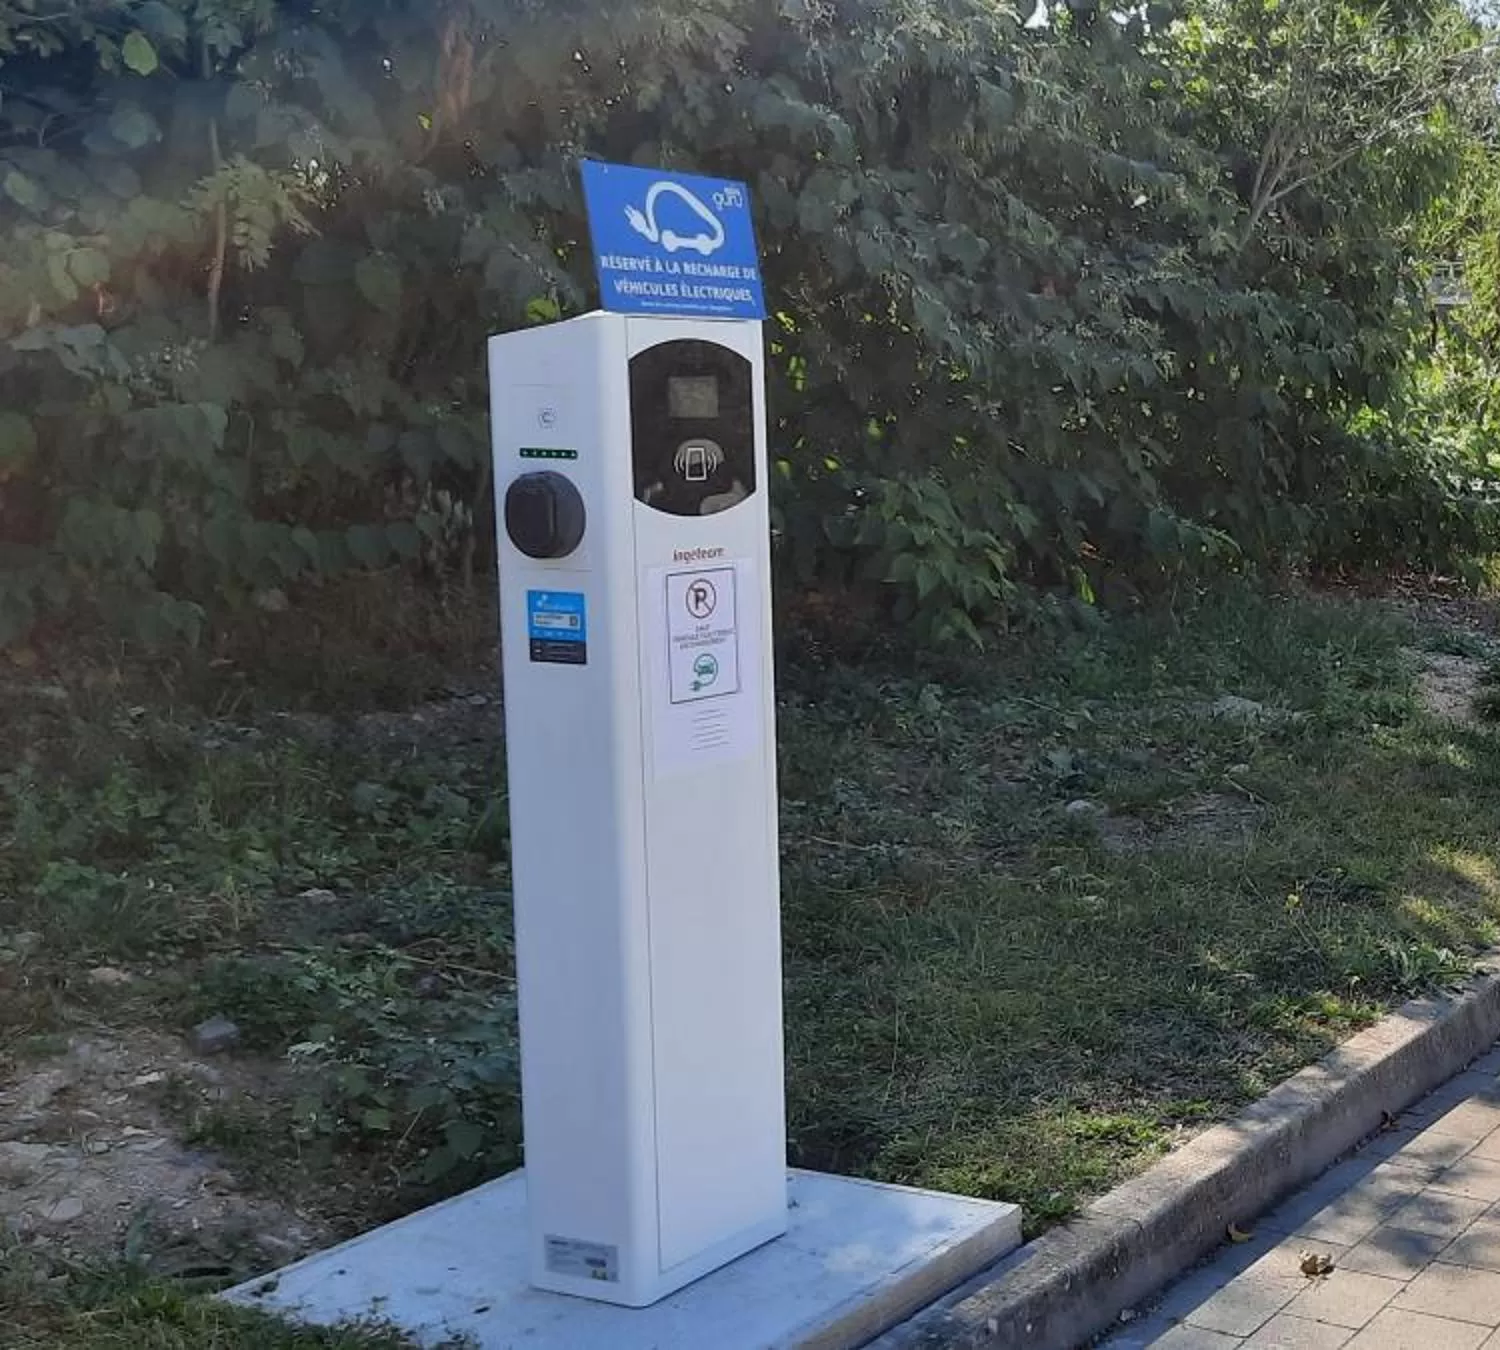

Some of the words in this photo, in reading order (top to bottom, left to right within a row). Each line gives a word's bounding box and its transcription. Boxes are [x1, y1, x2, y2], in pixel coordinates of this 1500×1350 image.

[601, 255, 651, 273] RÉSERVÉ
[665, 261, 681, 274] LA
[683, 263, 741, 280] RECHARGE
[741, 268, 757, 281] DE
[614, 278, 679, 297] VÉHICULES
